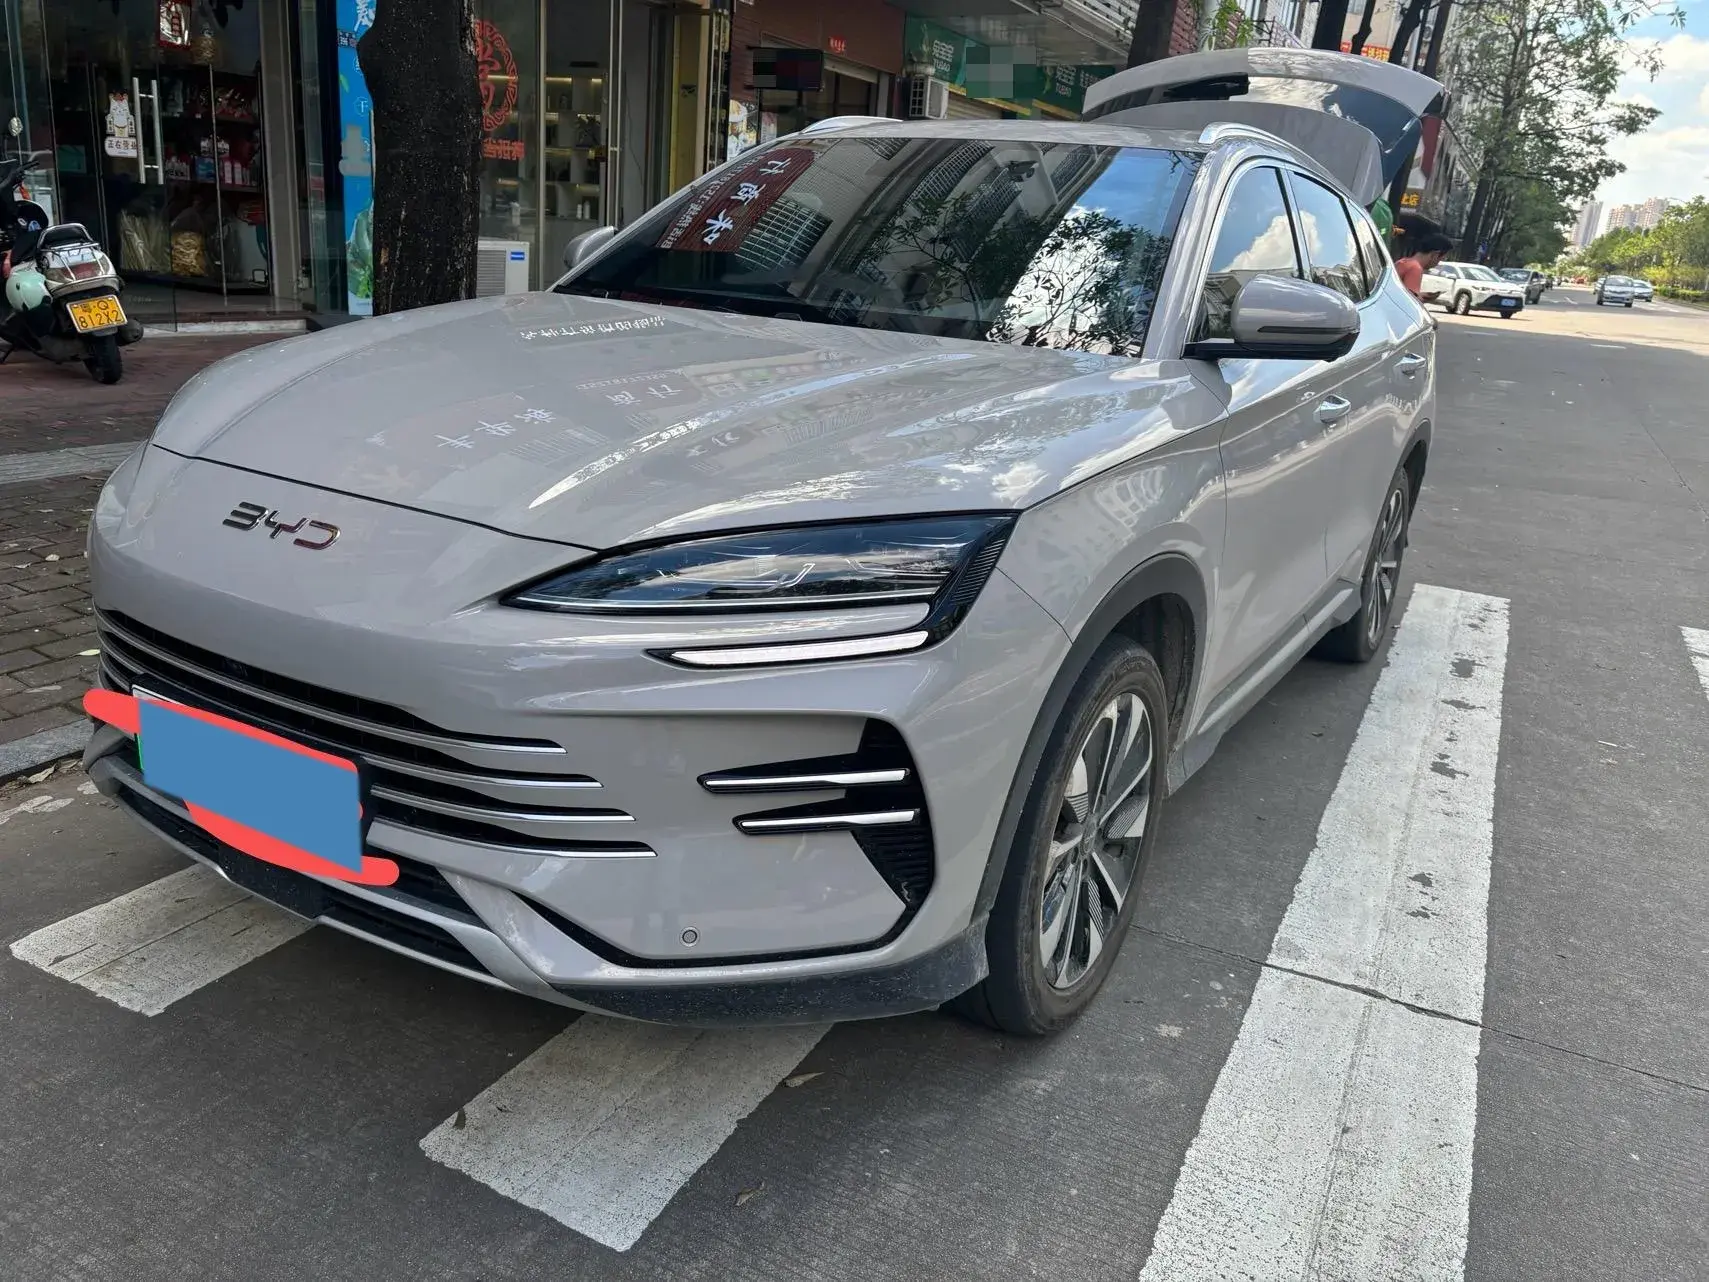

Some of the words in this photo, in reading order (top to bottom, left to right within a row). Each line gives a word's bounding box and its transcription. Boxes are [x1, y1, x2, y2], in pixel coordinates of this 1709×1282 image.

[932, 58, 951, 73] TUBAO
[79, 309, 122, 329] 812X2
[222, 501, 342, 551] BYD
